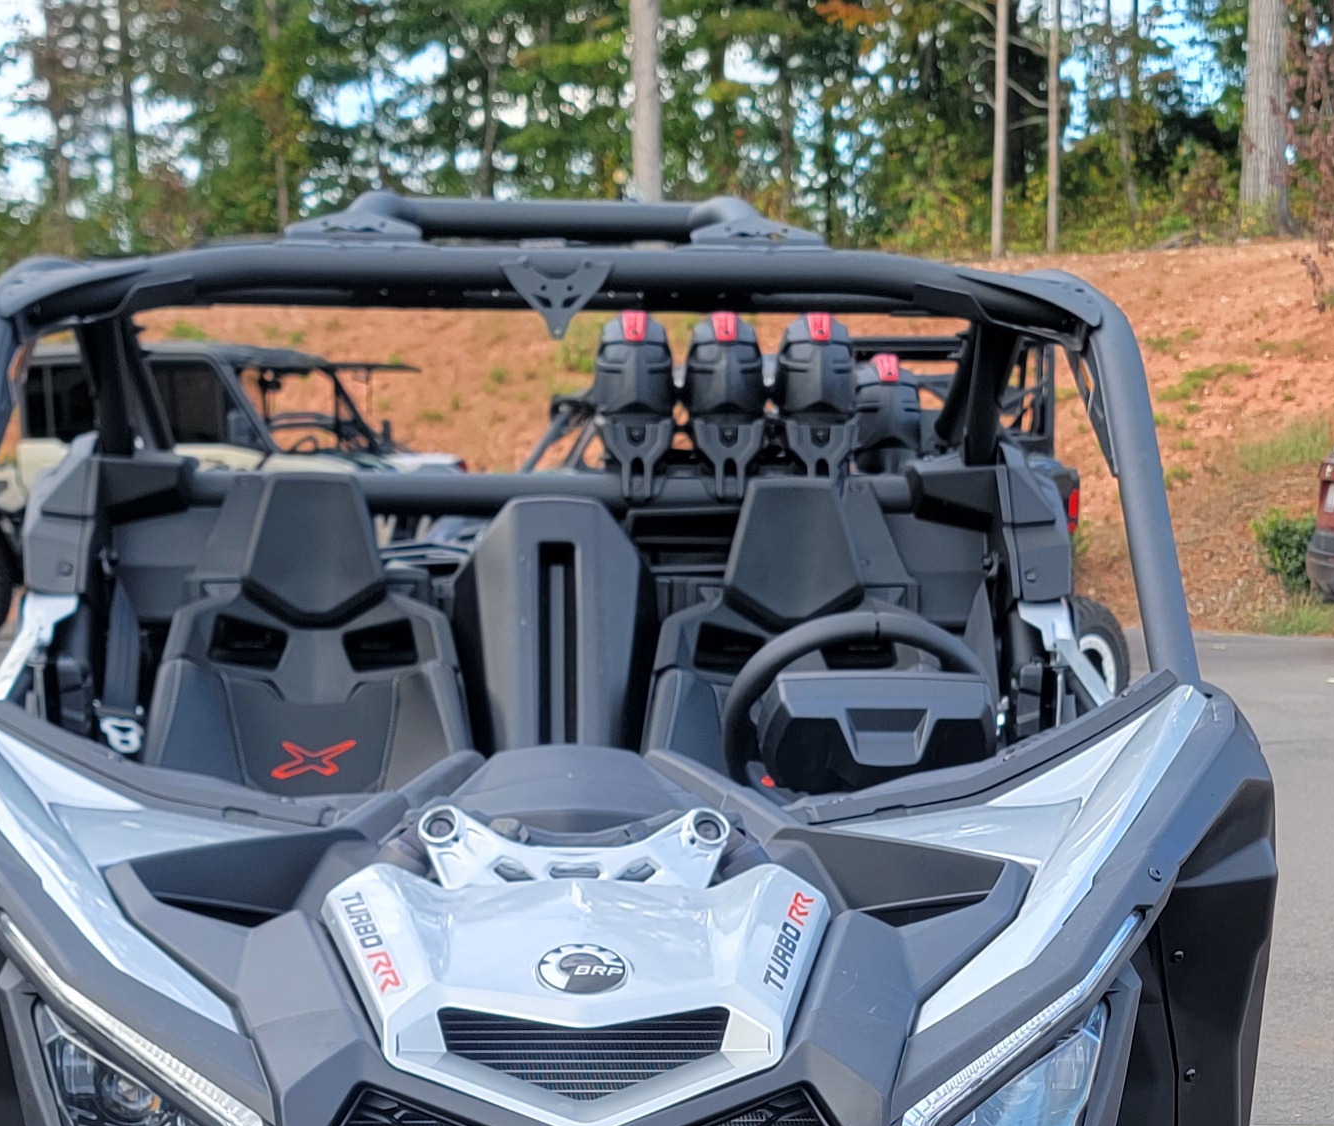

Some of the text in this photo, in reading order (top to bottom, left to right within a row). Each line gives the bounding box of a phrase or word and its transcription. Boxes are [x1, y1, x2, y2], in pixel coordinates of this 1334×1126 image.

[340, 892, 400, 994] TURBO RR
[573, 964, 624, 977] BRP
[762, 891, 814, 991] TURBO RR
